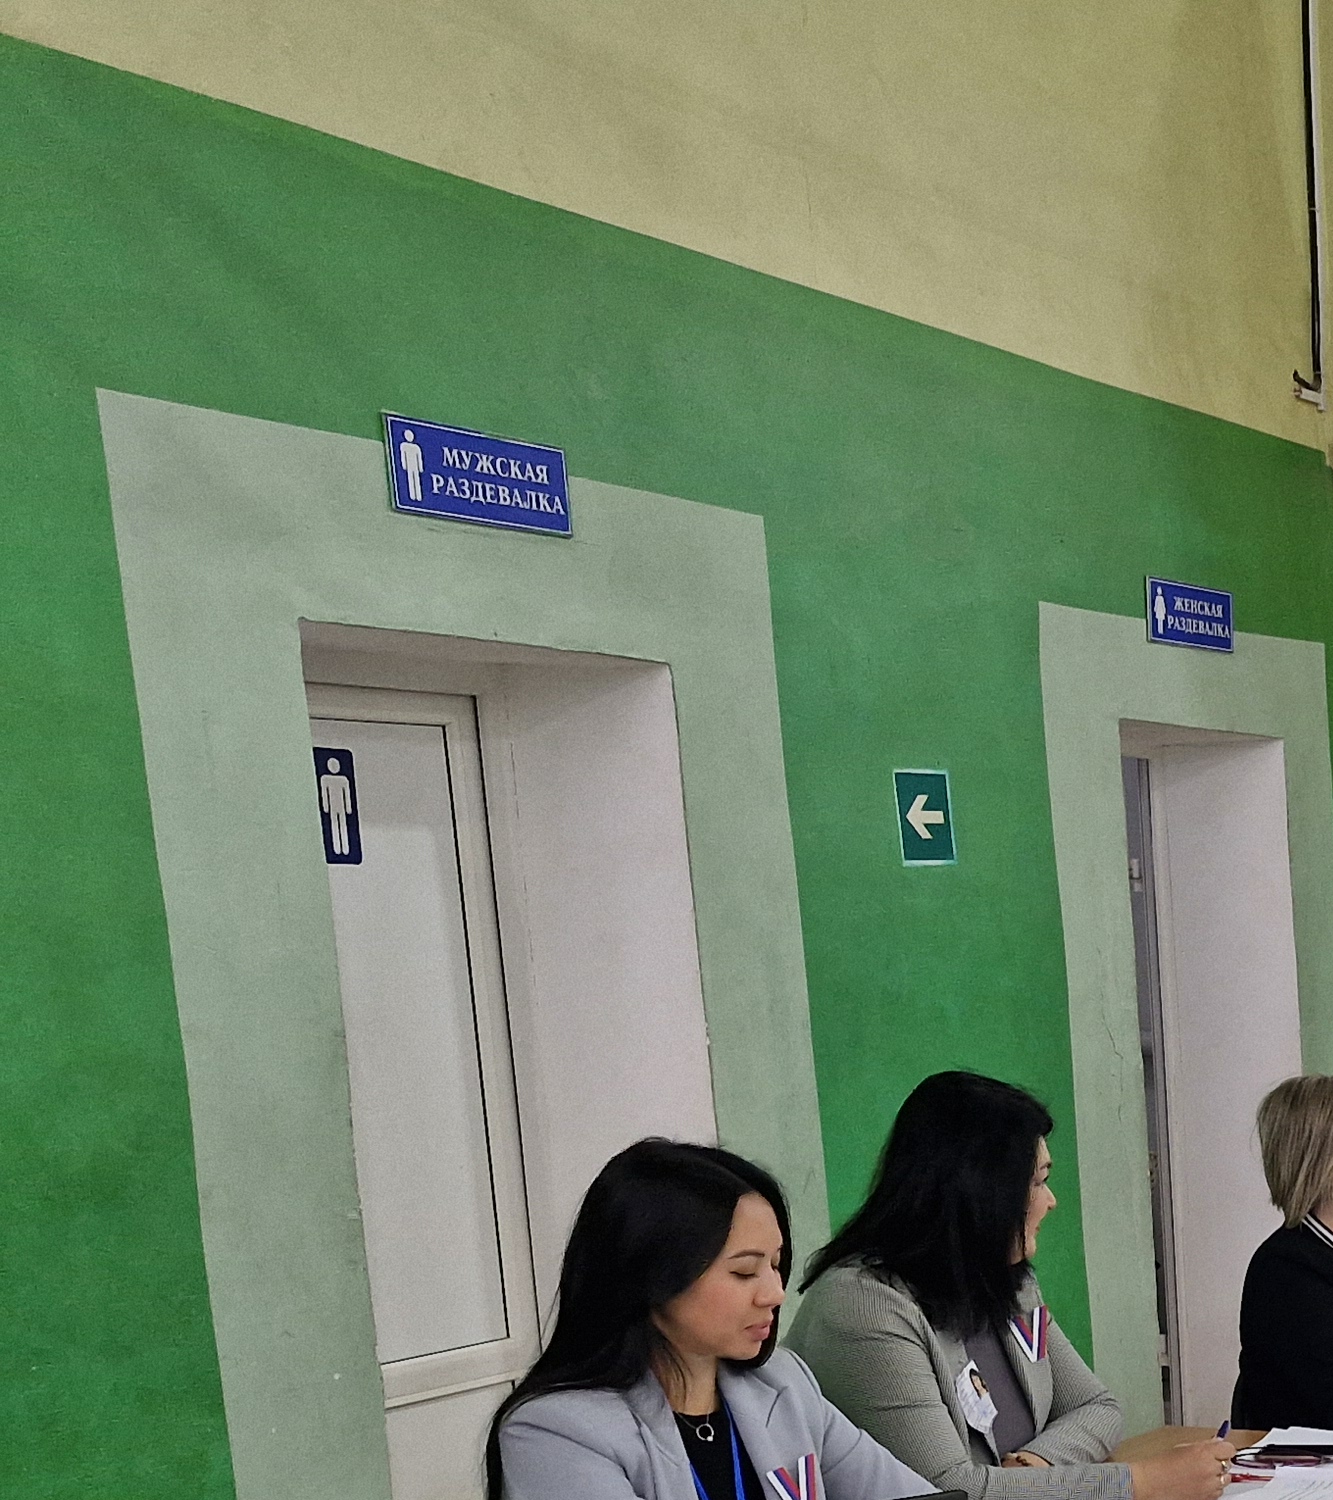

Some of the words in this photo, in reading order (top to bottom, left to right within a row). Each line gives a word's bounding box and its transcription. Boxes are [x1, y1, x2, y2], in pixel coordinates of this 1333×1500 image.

[443, 447, 549, 485] МУЖСКАЯ
[431, 474, 566, 515] РАЗДЕВАЛКА
[1173, 596, 1223, 618] ЖЕНСКАЯ
[1167, 615, 1230, 638] РАЗДЕВАЛКА
